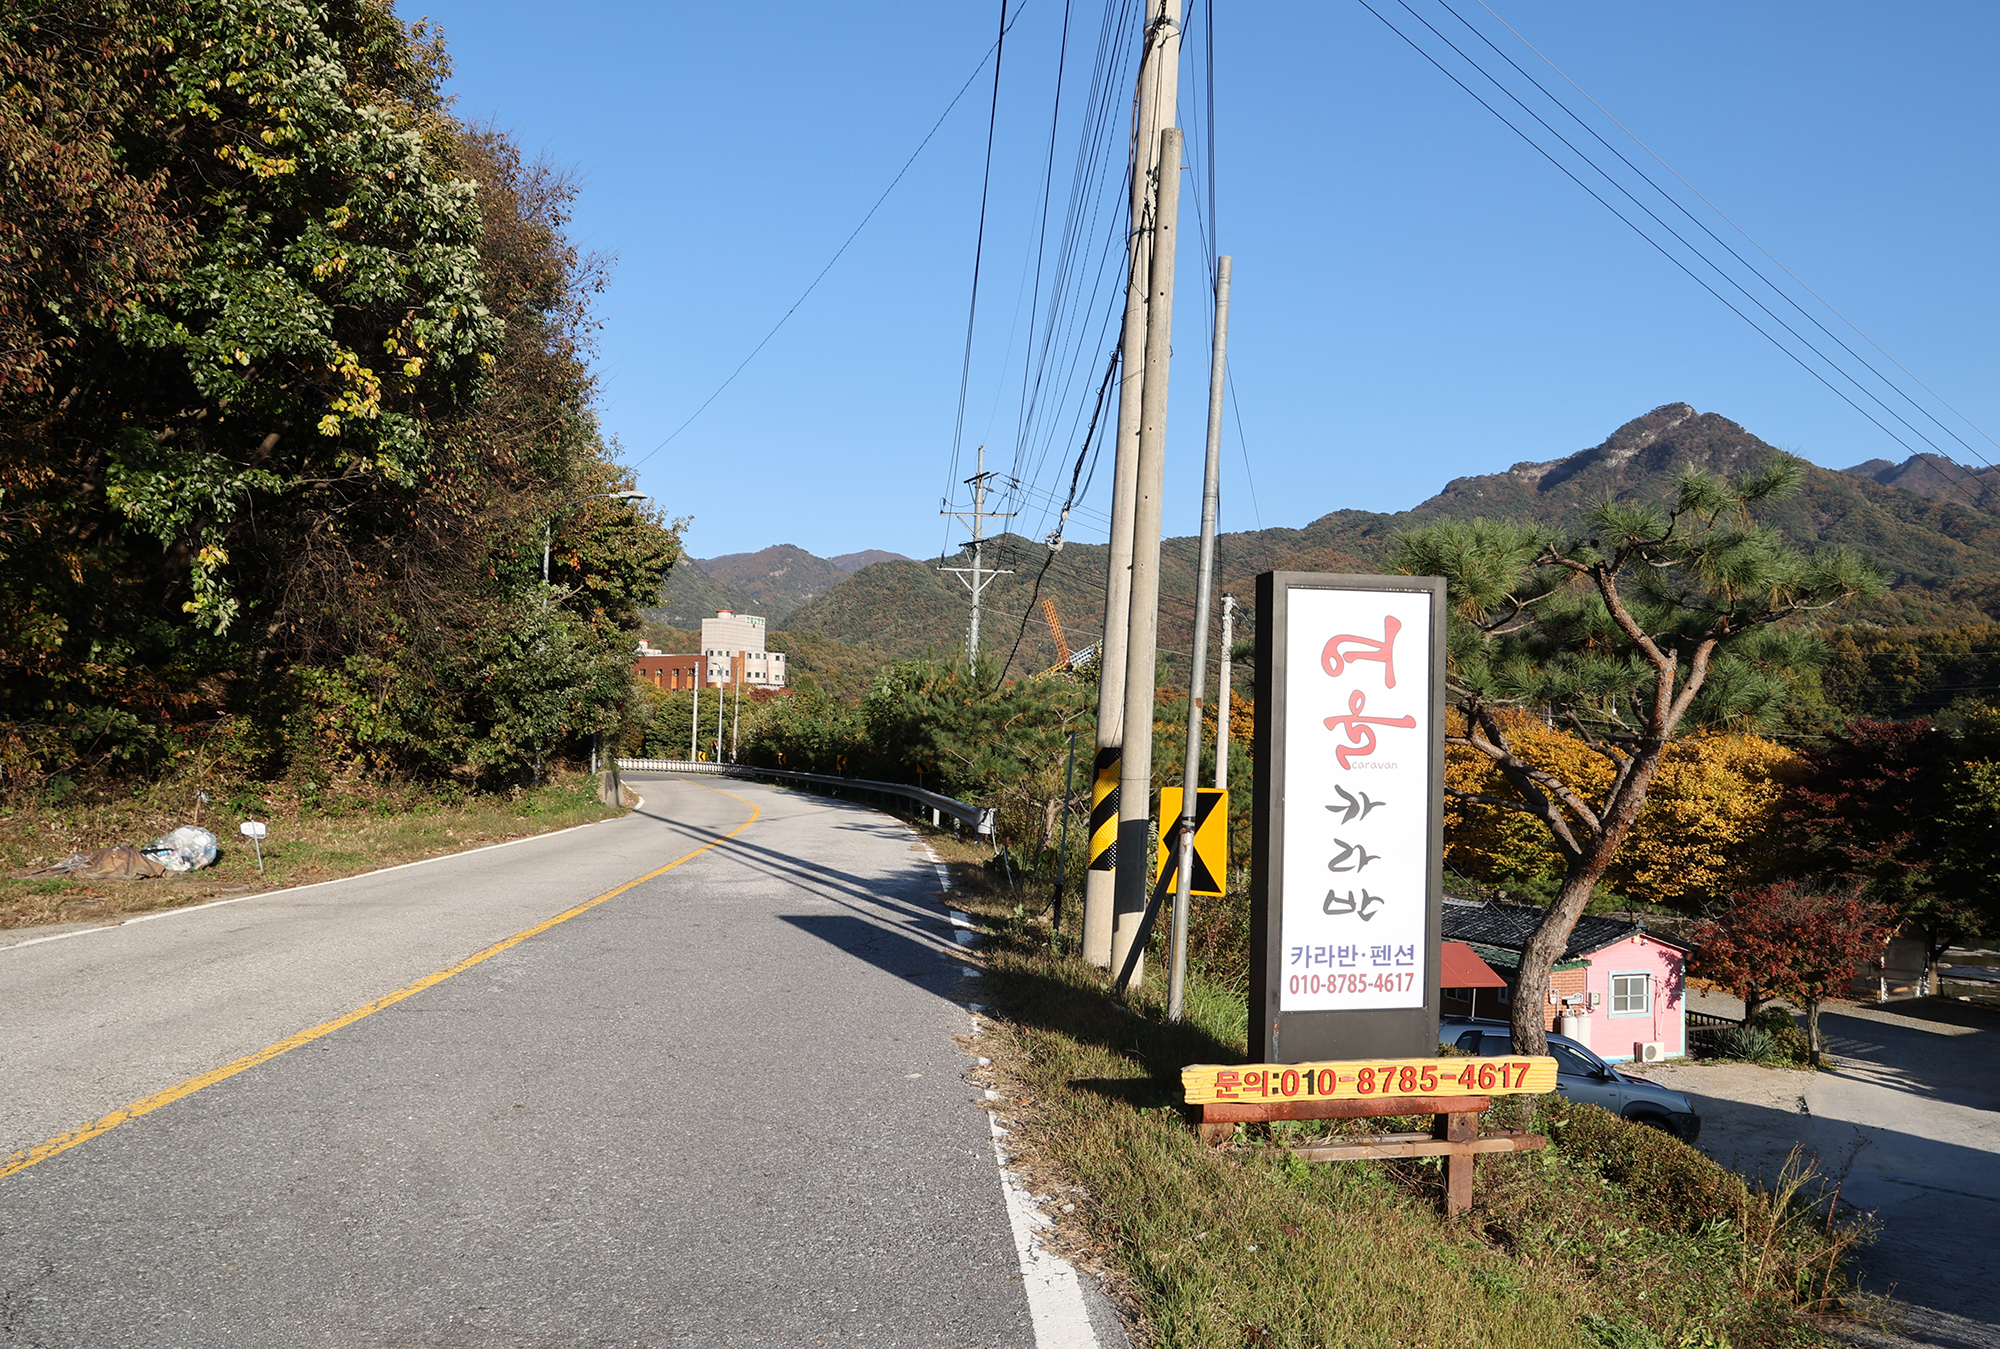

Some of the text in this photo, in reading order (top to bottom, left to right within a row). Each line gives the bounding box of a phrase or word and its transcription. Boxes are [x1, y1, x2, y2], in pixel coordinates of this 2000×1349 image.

[1352, 761, 1398, 770] caravan
[1323, 784, 1386, 921] 카라반
[1289, 972, 1414, 994] 010-8785-4617
